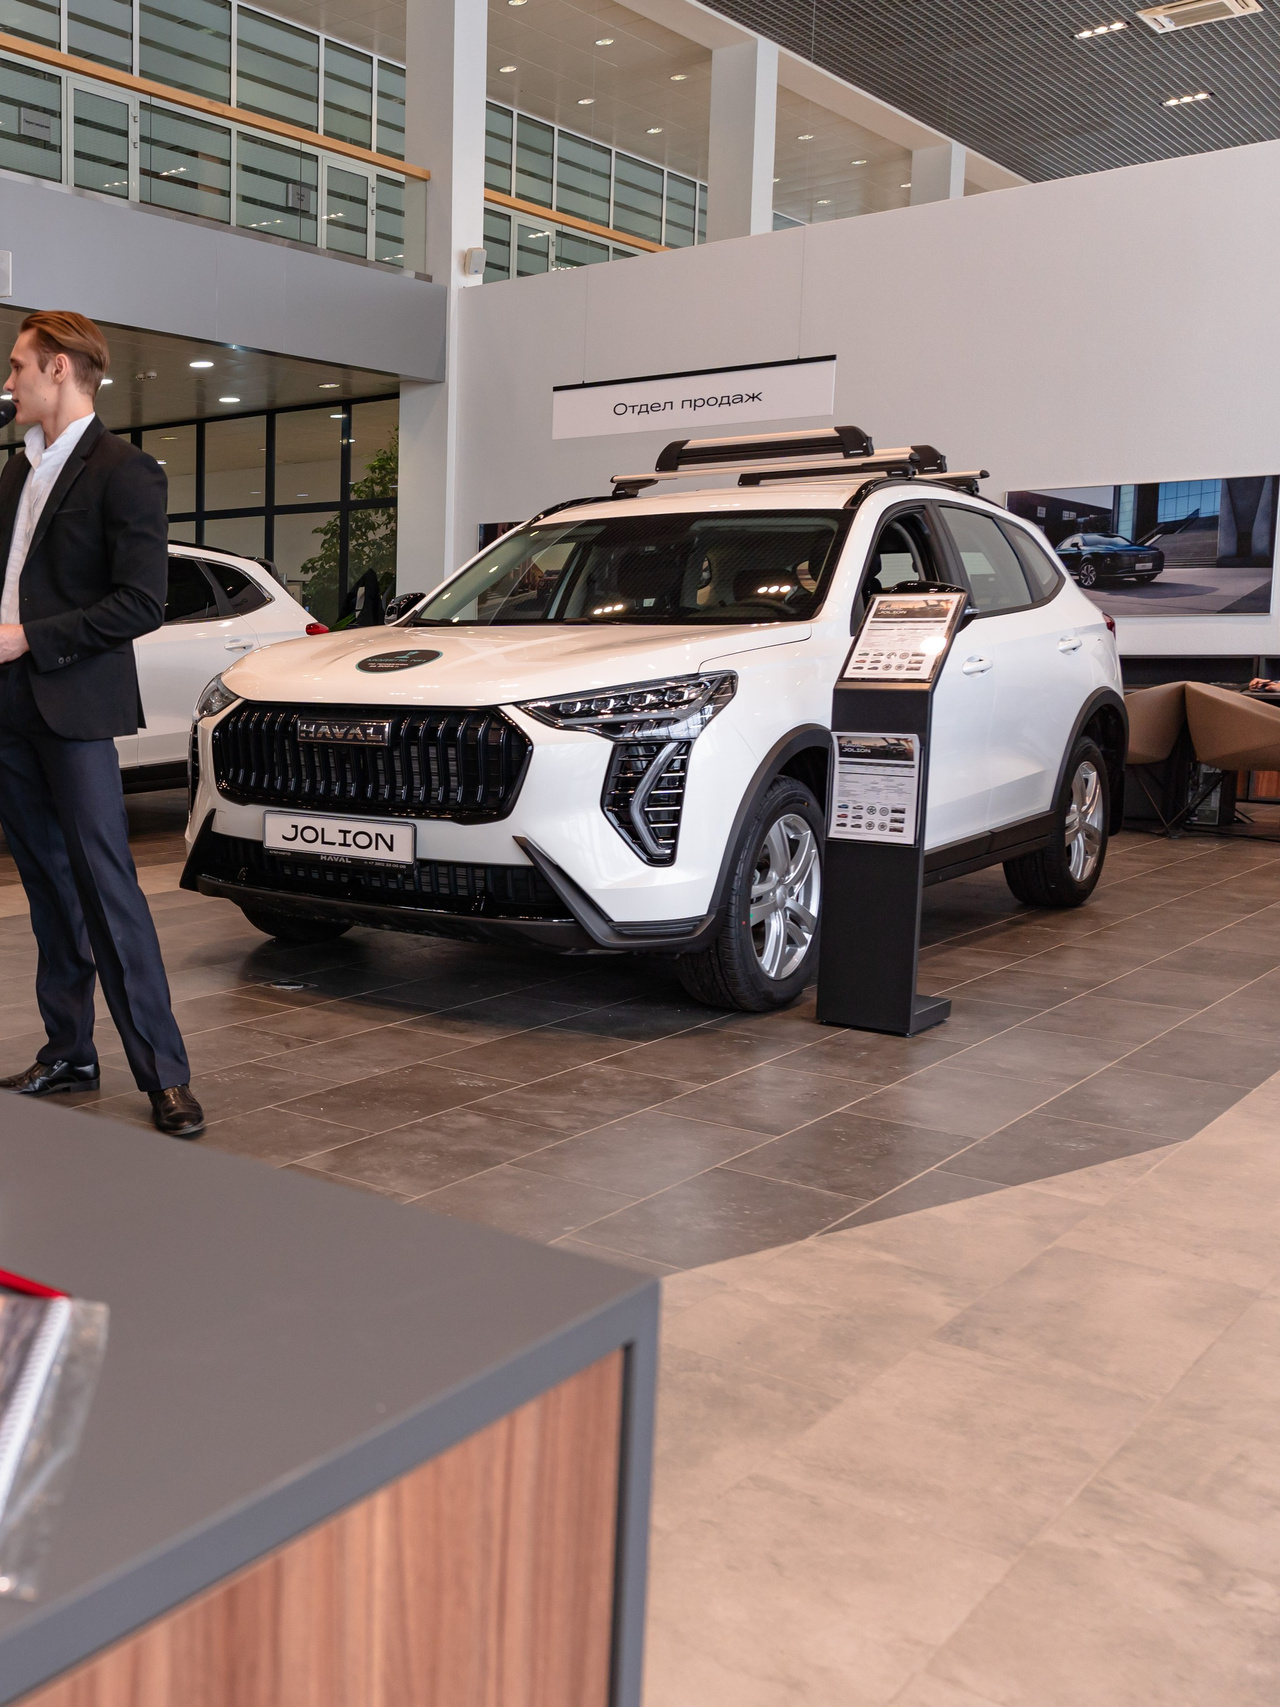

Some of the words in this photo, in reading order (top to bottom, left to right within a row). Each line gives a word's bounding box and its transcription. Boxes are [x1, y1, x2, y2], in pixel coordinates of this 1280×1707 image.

[613, 401, 674, 416] Отдел
[681, 391, 763, 411] продаж
[300, 724, 383, 741] HAVAL
[281, 823, 395, 853] JOLION
[320, 854, 352, 864] HAVAL
